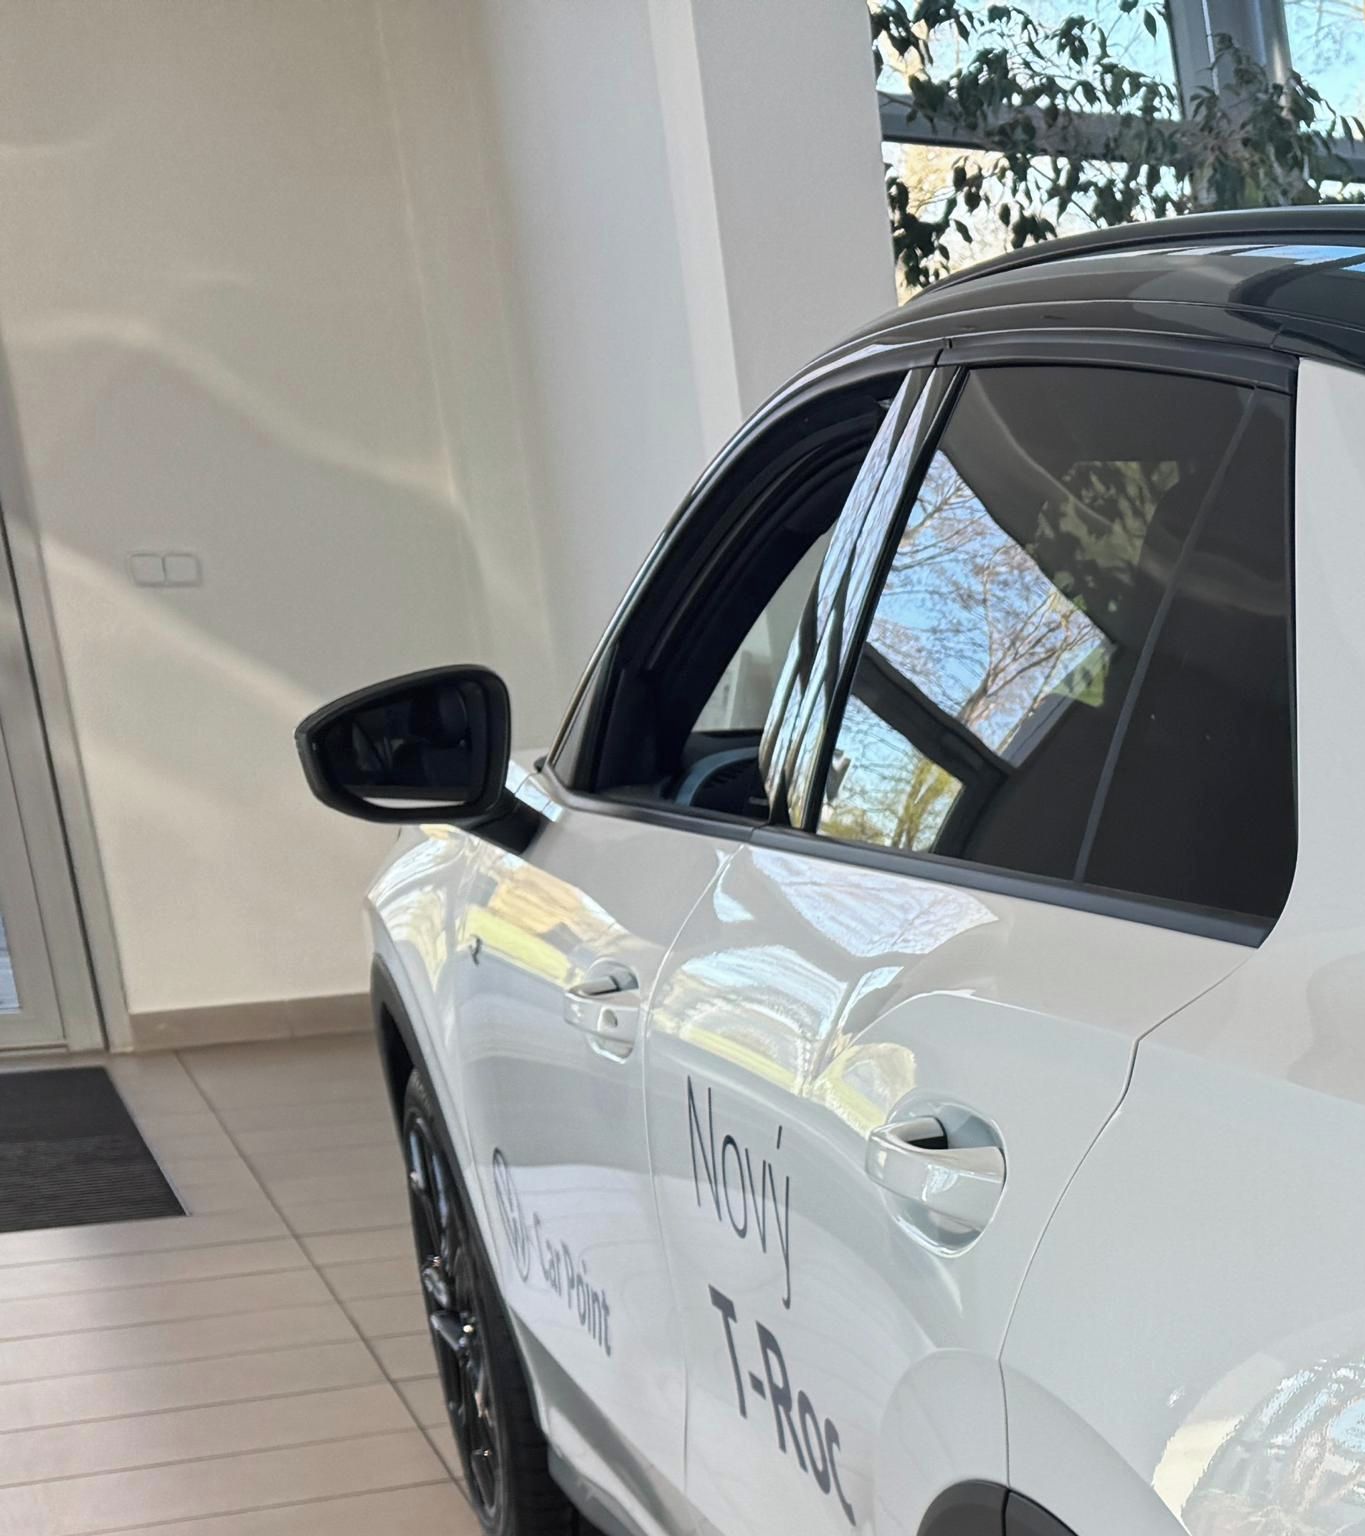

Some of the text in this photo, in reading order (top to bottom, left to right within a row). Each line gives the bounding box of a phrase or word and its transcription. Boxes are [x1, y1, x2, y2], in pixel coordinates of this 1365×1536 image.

[533, 1211, 611, 1358] Car Point
[687, 1075, 790, 1310] Nový
[708, 1283, 857, 1528] T-Roc
